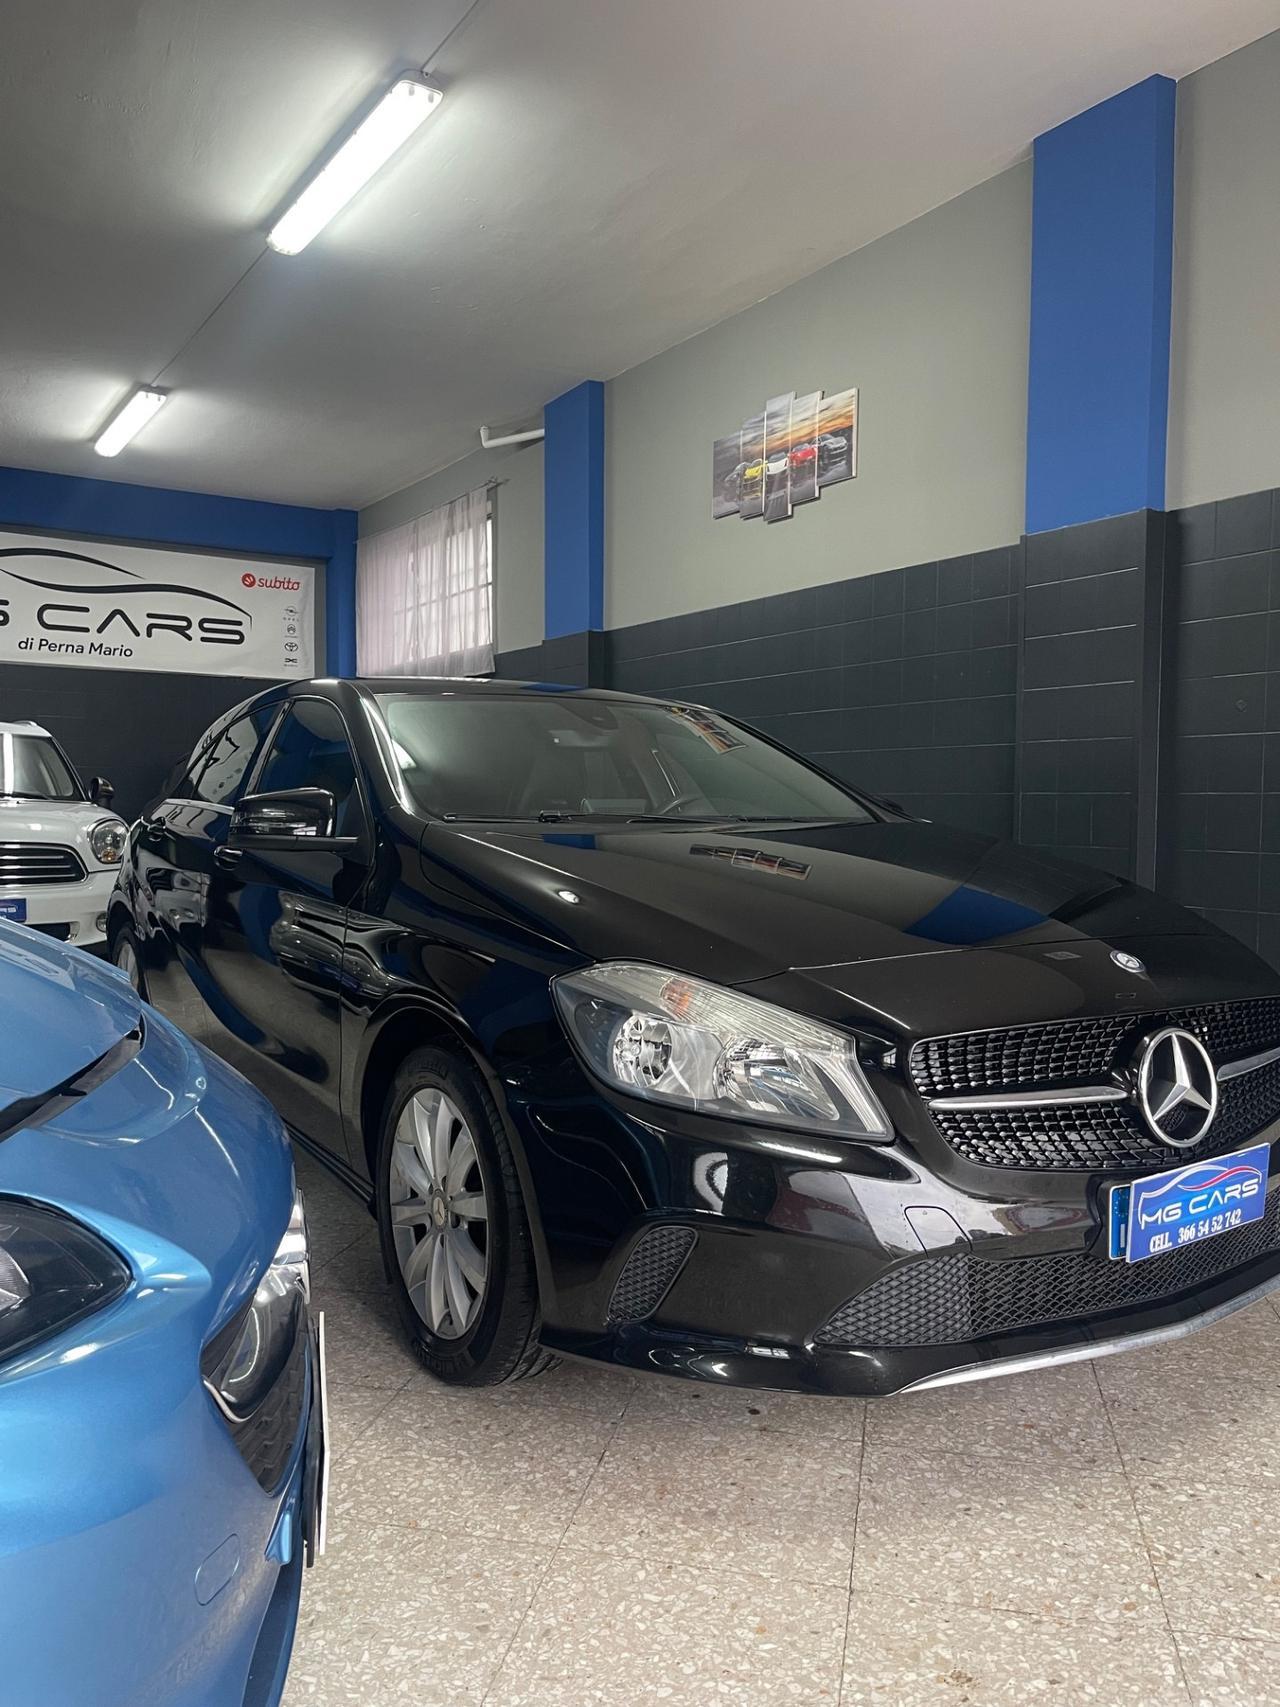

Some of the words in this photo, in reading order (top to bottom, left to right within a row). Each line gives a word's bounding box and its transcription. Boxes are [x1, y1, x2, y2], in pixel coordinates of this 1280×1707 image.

[258, 576, 300, 591] subito
[37, 603, 245, 645] CARS
[18, 637, 34, 650] di
[38, 638, 85, 654] Perna
[88, 642, 133, 657] Mario
[1141, 1202, 1182, 1230] MG
[1189, 1178, 1259, 1214] CARS
[1150, 1232, 1172, 1253] CELL.
[1178, 1223, 1196, 1243] 366
[1198, 1218, 1210, 1237] 54
[1211, 1214, 1223, 1233] 52
[1225, 1208, 1242, 1228] 742
